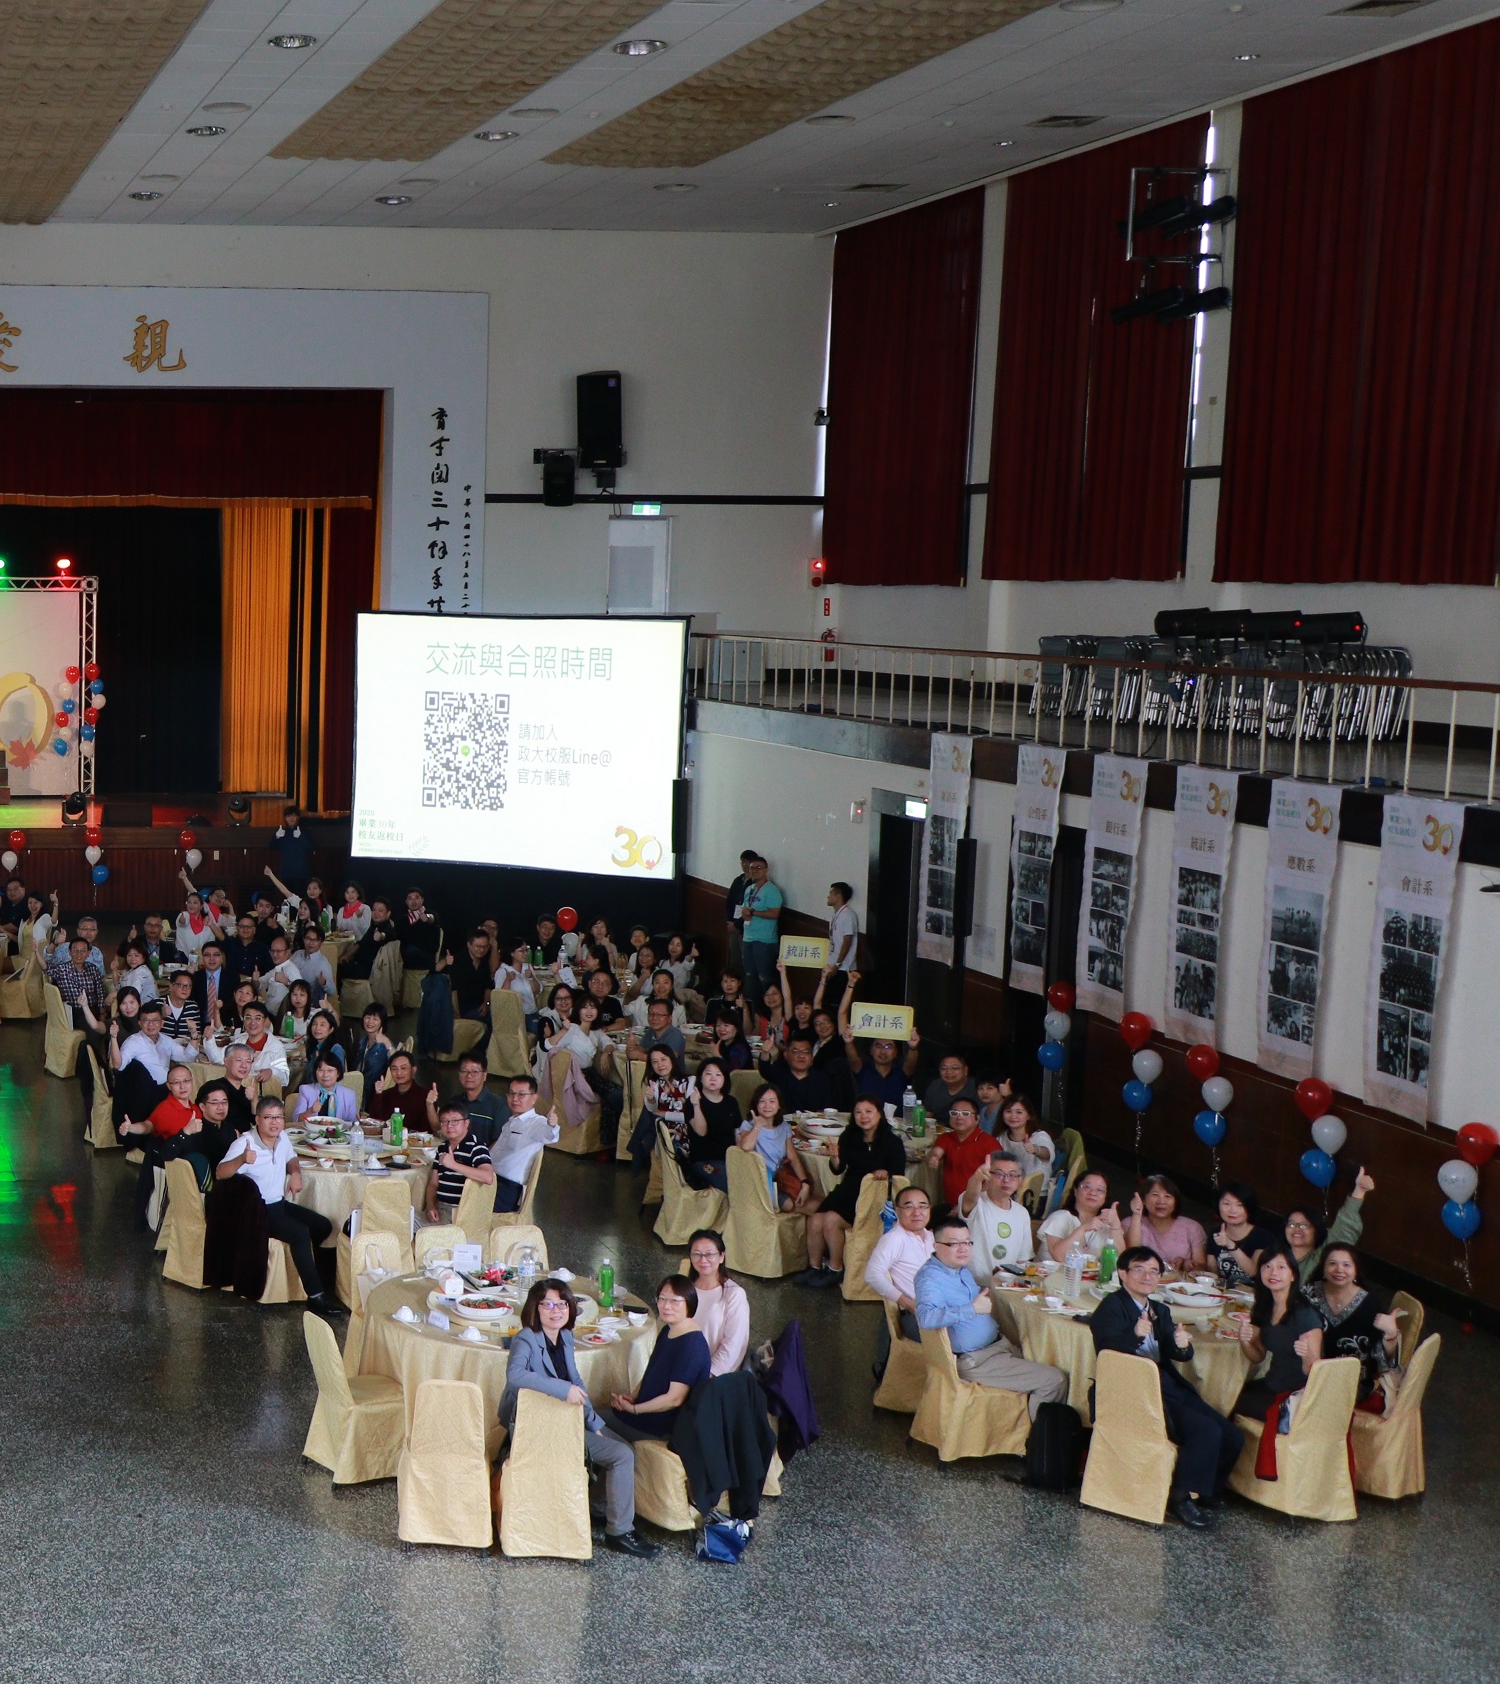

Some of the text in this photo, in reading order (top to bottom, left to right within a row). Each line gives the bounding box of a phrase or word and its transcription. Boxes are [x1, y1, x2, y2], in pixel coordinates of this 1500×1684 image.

[425, 642, 613, 681] 交流與合照時間
[518, 723, 558, 741] 請加入
[517, 768, 571, 787] 官方帳號
[1402, 876, 1433, 896] 會計系
[786, 944, 821, 959] 統計系
[861, 1013, 904, 1029] 會計系
